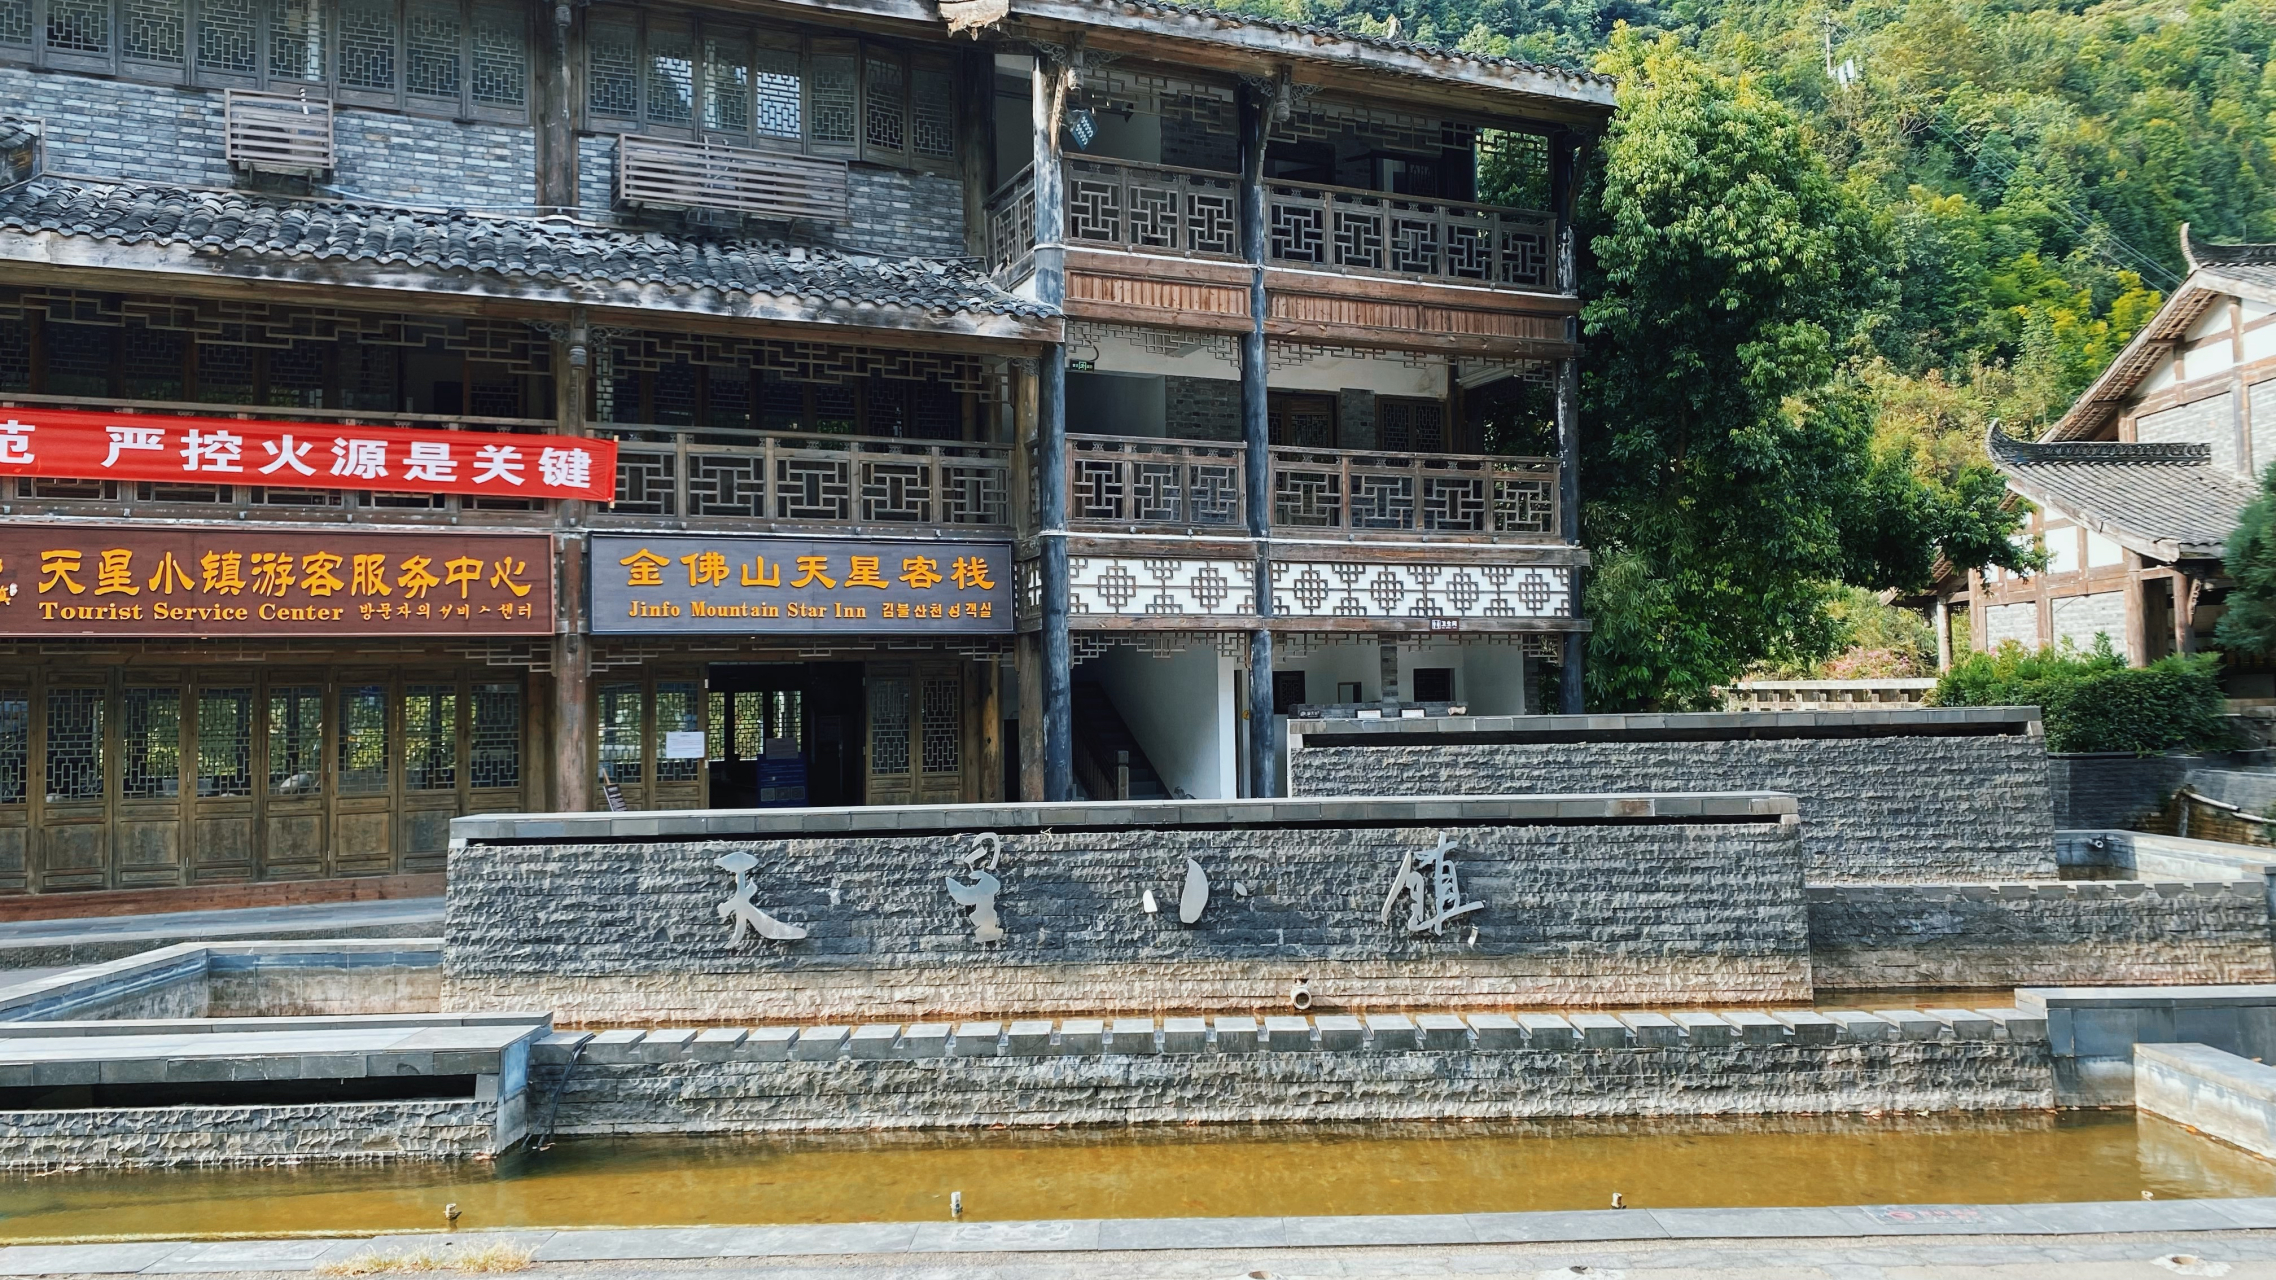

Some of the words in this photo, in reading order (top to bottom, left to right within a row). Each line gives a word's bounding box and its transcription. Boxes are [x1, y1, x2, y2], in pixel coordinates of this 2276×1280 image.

[100, 425, 593, 489] 严控火源是关键
[38, 548, 532, 600] 天星小镇游客服务中心
[619, 548, 996, 590] 金佛山天星客栈
[38, 602, 144, 620] Tourist
[153, 602, 248, 621] Service
[258, 602, 344, 621] Center
[628, 600, 681, 617] Jinfo
[690, 601, 780, 618] Mountain
[787, 602, 828, 618] Star
[834, 602, 867, 618] Inn
